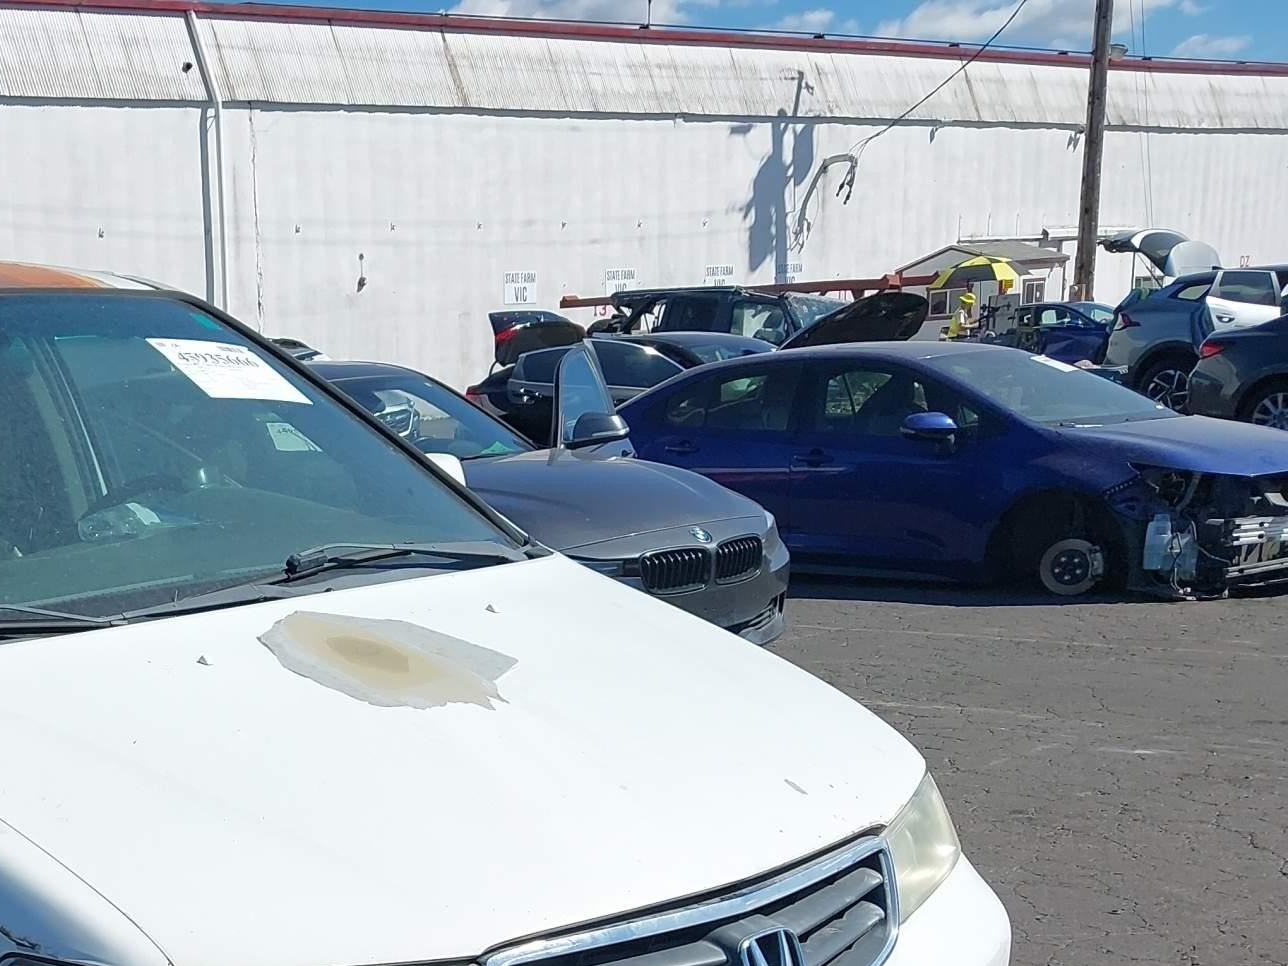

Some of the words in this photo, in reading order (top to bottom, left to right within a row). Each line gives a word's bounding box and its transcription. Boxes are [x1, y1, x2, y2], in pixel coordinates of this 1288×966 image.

[706, 265, 720, 277] STATE
[720, 264, 734, 276] FARM
[790, 263, 803, 273] FARM
[505, 272, 520, 284] STATE
[521, 272, 536, 284] FARM
[606, 270, 620, 281] STATE
[620, 269, 636, 280] FARM
[514, 286, 528, 303] VIC
[593, 304, 607, 317] 13
[177, 352, 260, 368] 45935666
